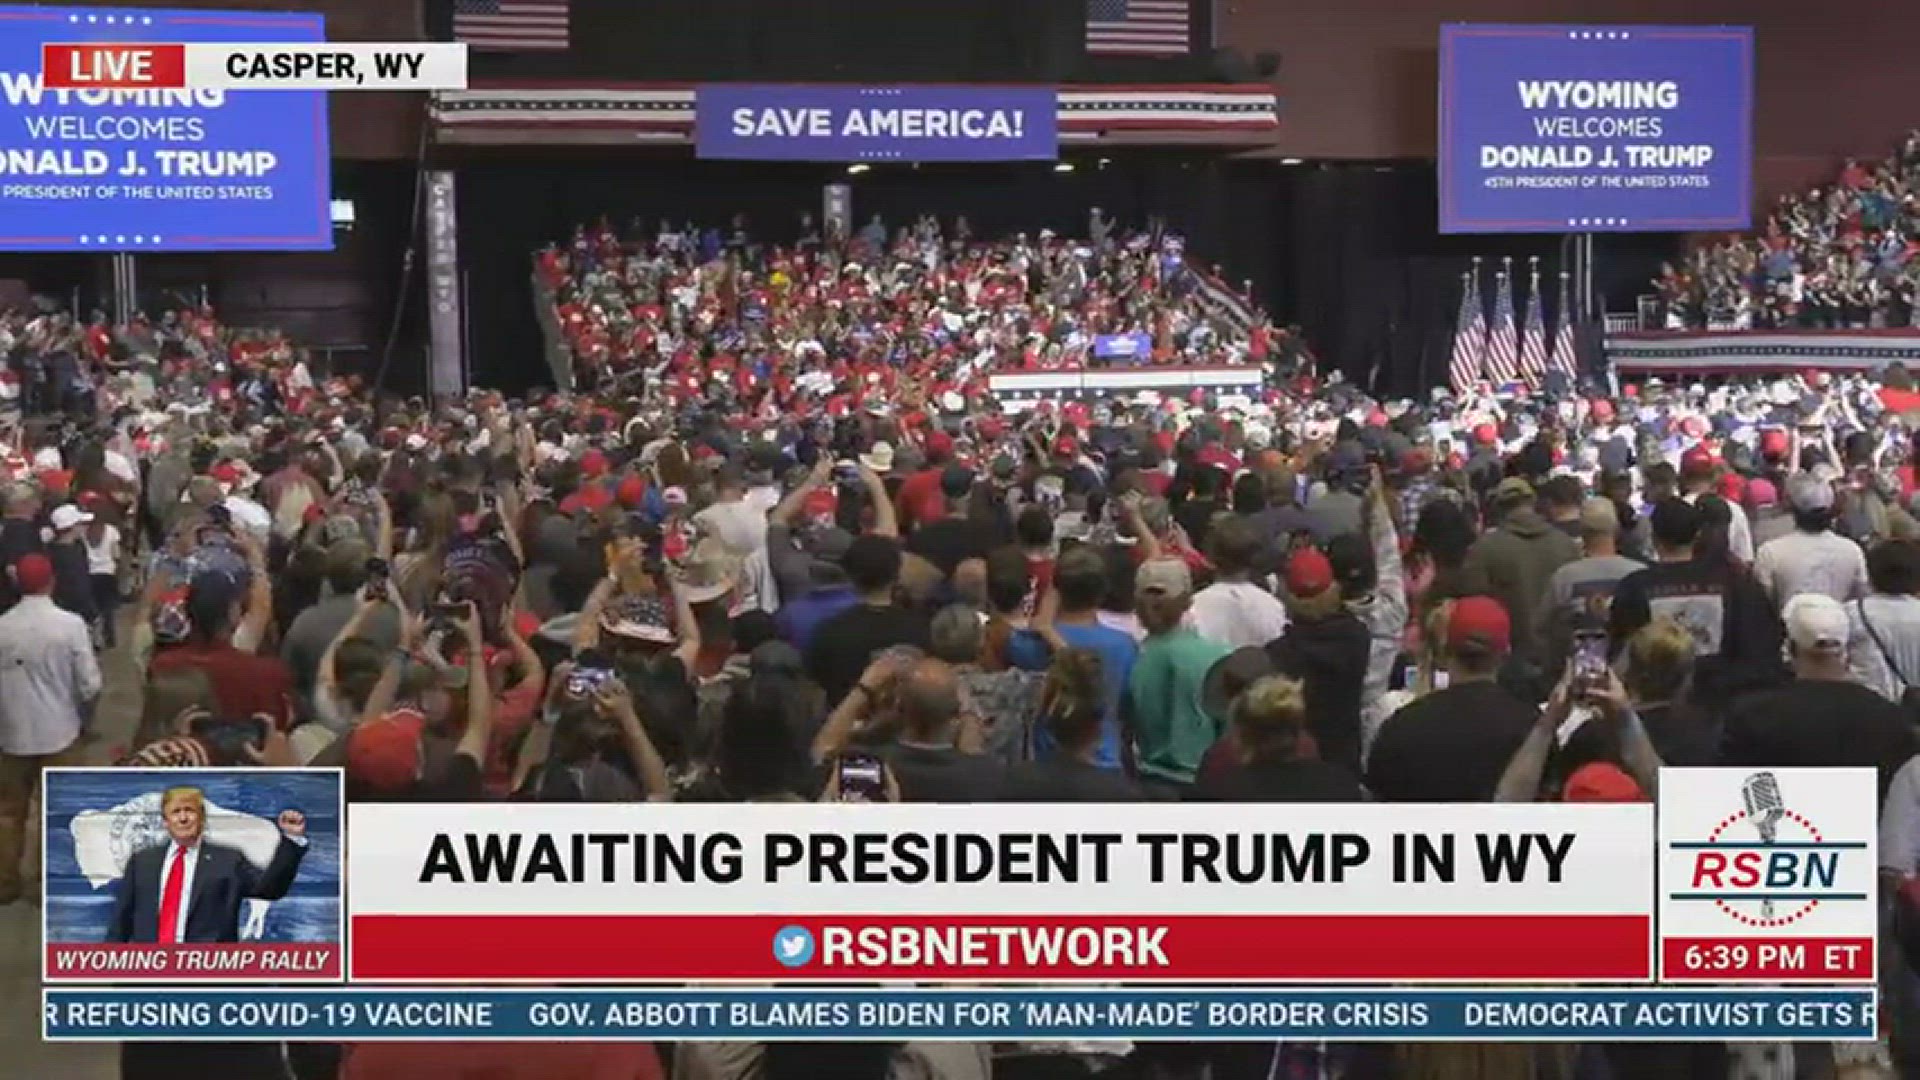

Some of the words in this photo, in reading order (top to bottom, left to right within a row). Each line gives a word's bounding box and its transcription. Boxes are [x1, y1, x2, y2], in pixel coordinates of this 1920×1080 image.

[1518, 81, 1679, 109] WYOMING
[26, 116, 205, 141] WELCOMES
[732, 108, 832, 137] SAVE
[842, 109, 1024, 138] AMERICA!
[1534, 116, 1663, 138] WELCOMES
[0, 150, 109, 175] NALD
[118, 150, 147, 176] J.
[155, 150, 277, 177] TRUMP
[1480, 145, 1592, 168] DONALD
[1597, 146, 1619, 168] J.
[1624, 145, 1713, 168] TRUMP
[3, 185, 92, 199] PRESIDENT
[96, 186, 119, 199] OF
[123, 186, 153, 199] THE
[156, 186, 215, 199] UNITED
[217, 186, 274, 200] STATES
[1516, 175, 1579, 188] PRESIDENT
[1581, 175, 1598, 188] OF
[1601, 175, 1622, 187] THE
[1624, 175, 1667, 187] UNITED
[1668, 175, 1710, 188] STATES
